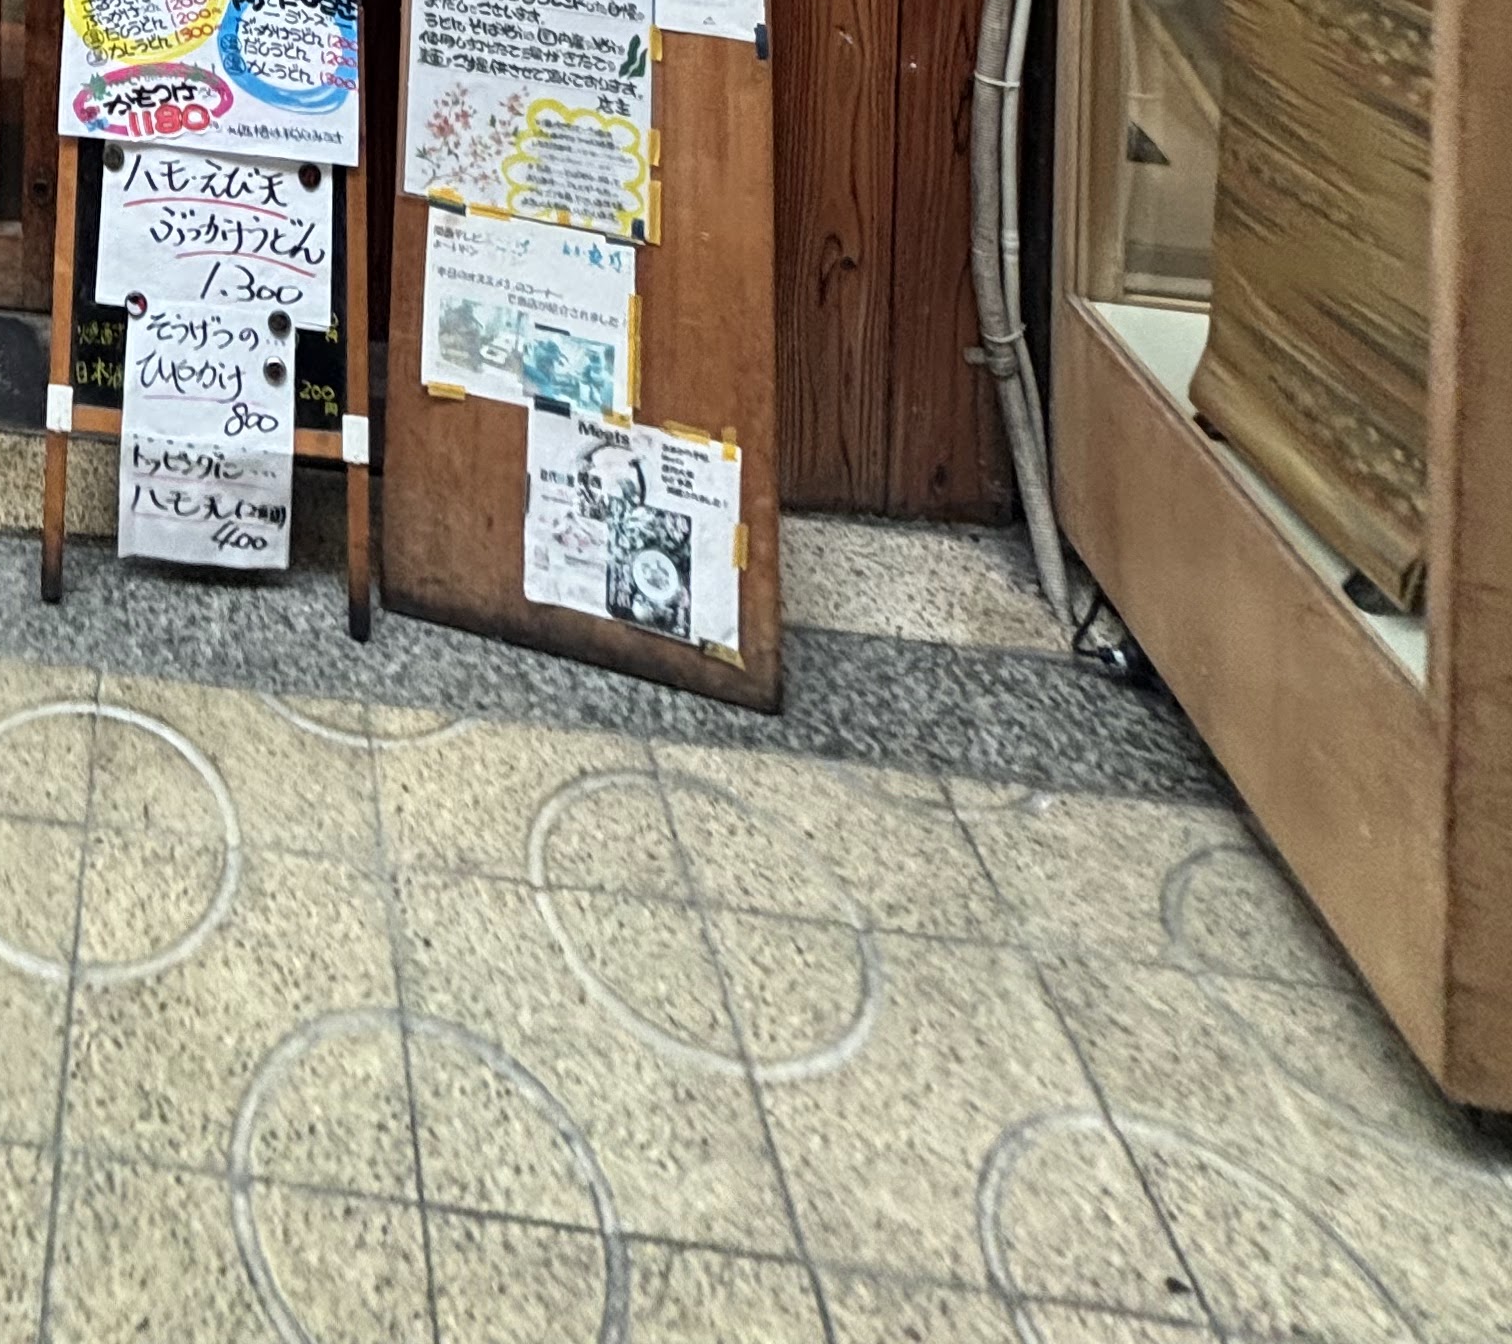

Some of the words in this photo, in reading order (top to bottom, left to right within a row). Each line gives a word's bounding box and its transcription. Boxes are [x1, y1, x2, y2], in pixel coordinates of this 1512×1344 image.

[129, 103, 211, 138] 1180
[149, 205, 325, 266] ぶっかけうどん
[299, 379, 336, 401] 200
[223, 402, 279, 436] 800
[210, 519, 268, 553] 400
